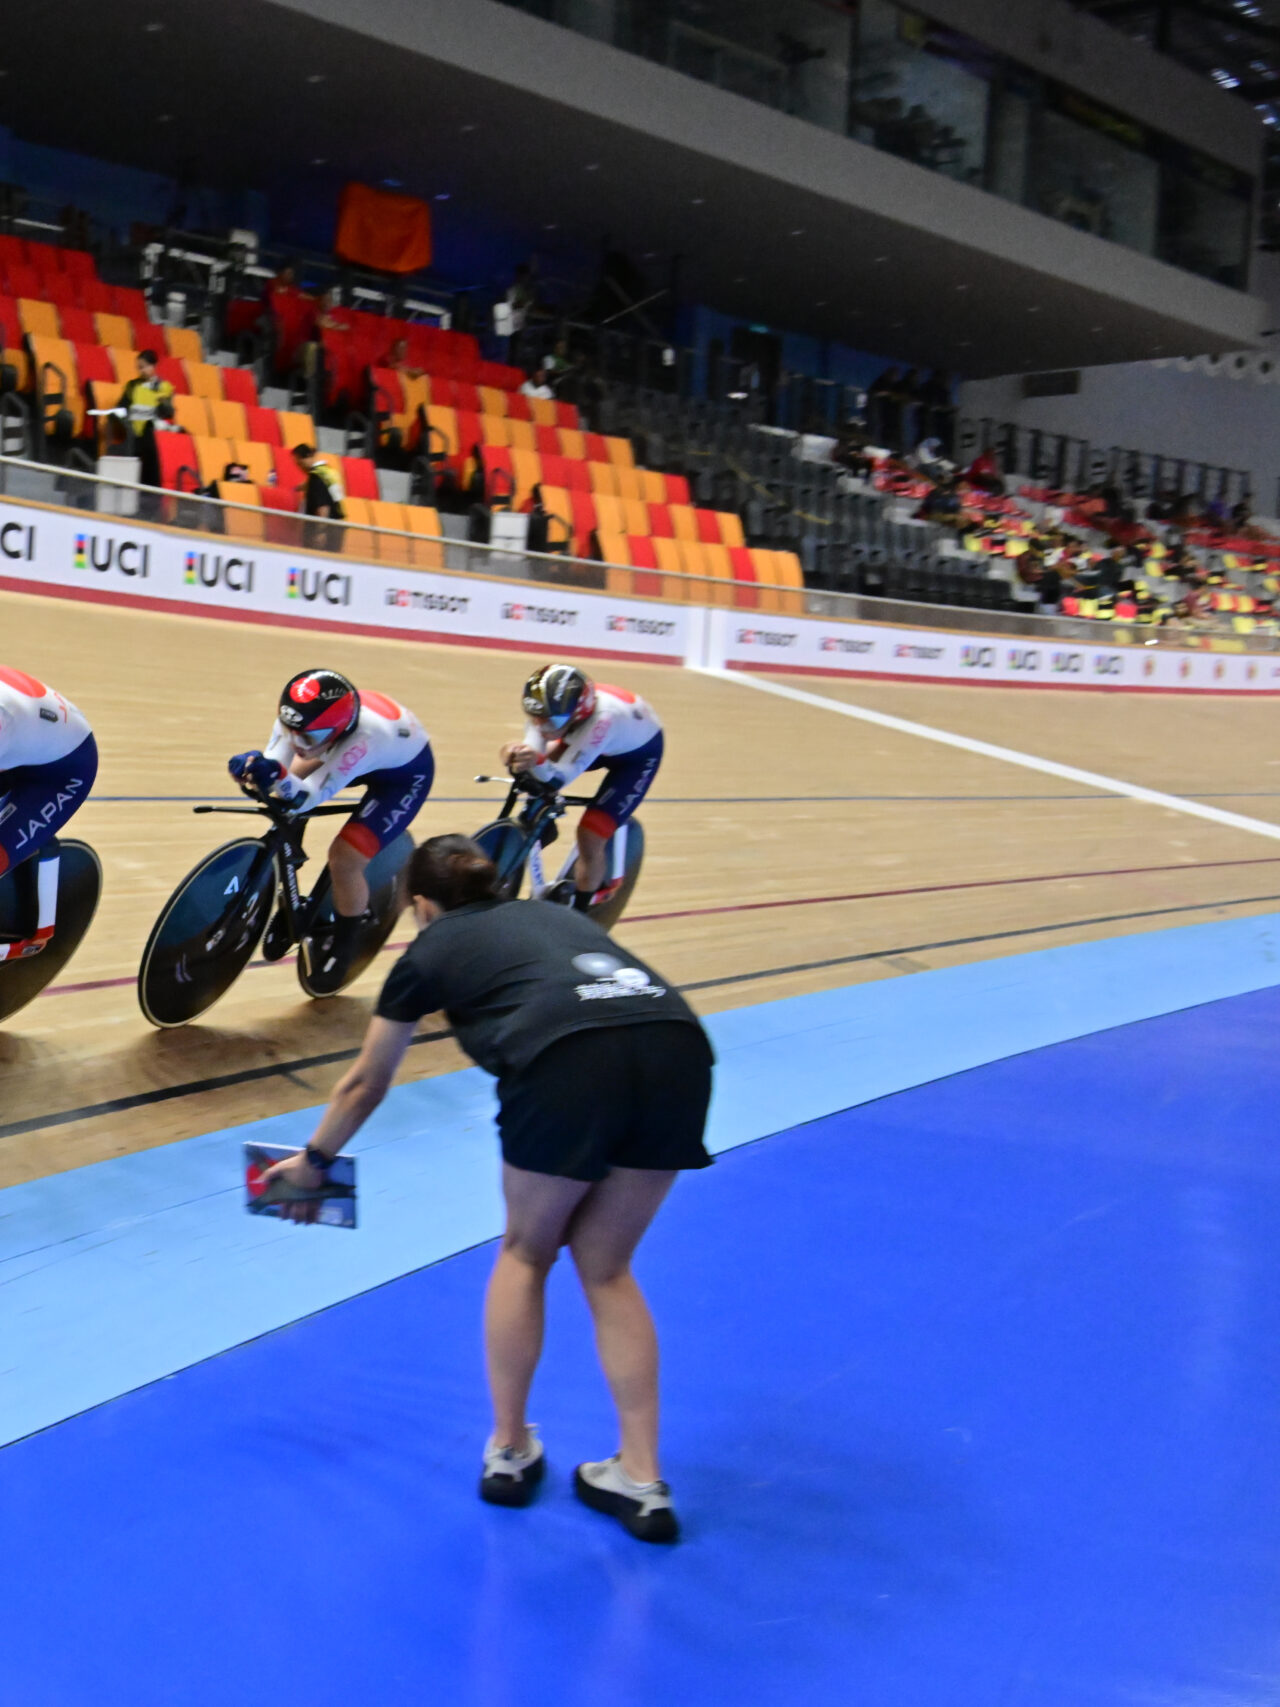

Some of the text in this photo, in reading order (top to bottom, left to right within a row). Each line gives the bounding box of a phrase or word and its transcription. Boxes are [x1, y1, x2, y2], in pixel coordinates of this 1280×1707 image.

[90, 536, 150, 577] UCI
[197, 553, 255, 593] UCI
[299, 569, 352, 606] UCI
[16, 778, 83, 849] JAPAN
[382, 774, 426, 834] JAPAN
